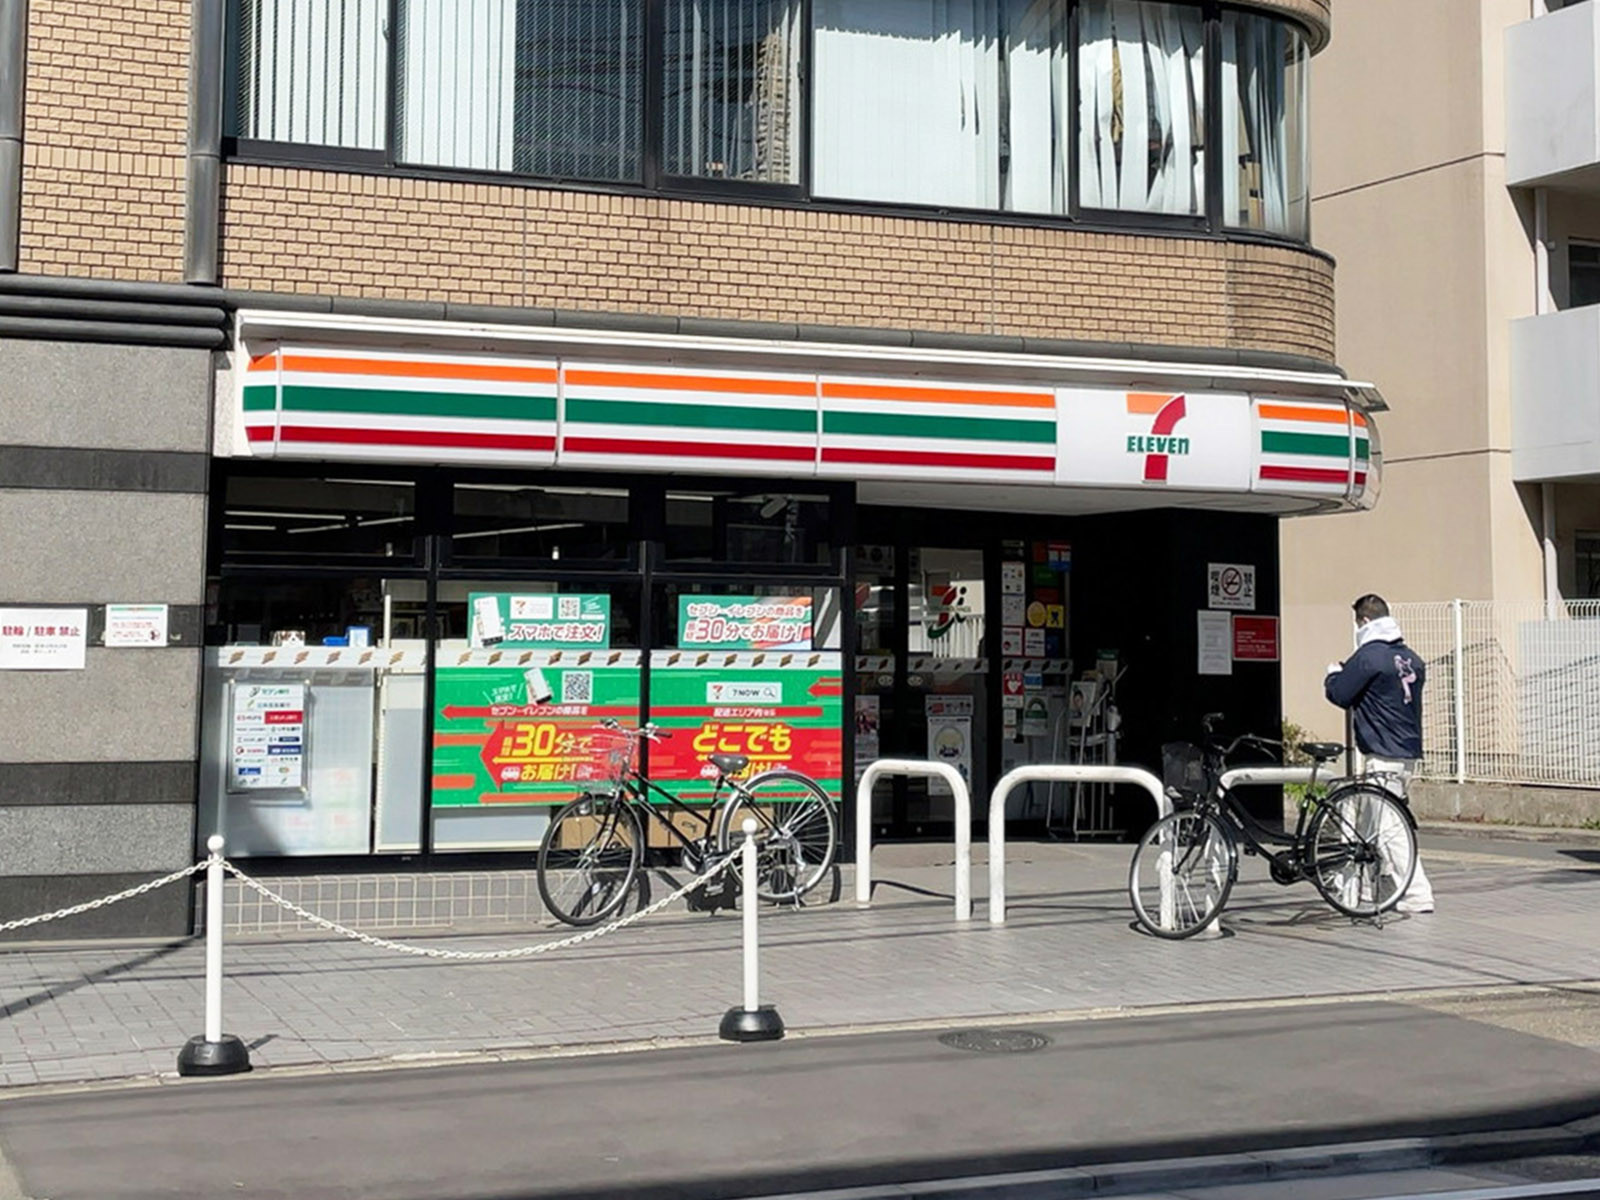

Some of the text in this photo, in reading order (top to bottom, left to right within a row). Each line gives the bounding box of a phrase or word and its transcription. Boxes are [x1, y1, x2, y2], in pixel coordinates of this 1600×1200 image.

[59, 625, 81, 637] 禁止
[509, 624, 604, 640] スマホで注文!
[732, 688, 761, 698] 7NOW
[692, 724, 792, 753] どこでも
[520, 763, 577, 781] お届け!
